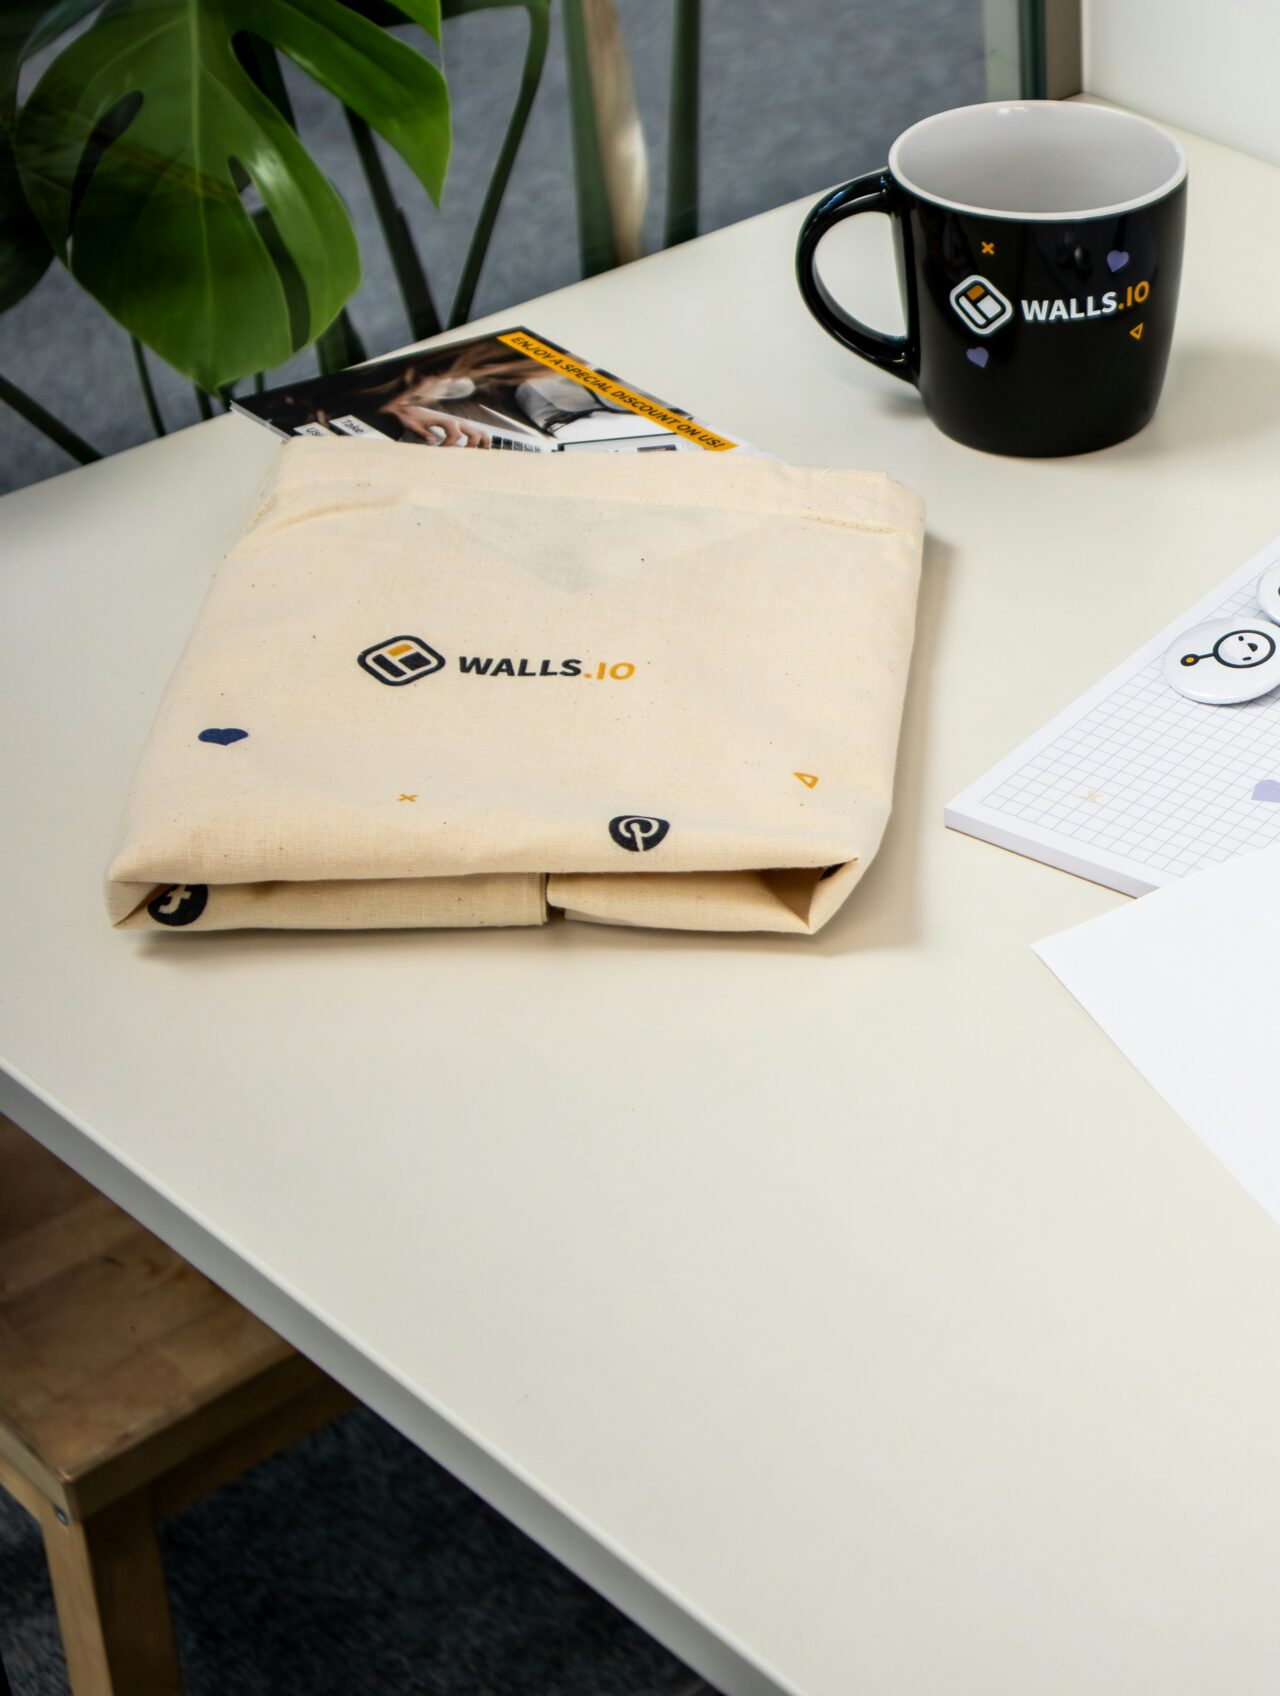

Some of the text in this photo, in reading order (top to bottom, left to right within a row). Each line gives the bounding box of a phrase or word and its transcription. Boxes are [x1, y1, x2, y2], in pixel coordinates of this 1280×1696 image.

[1021, 280, 1150, 322] WALLS.IO
[511, 336, 725, 447] ENJOY A SPECIAL DISCOUNT ON US!
[458, 656, 636, 681] WALLS.IO
